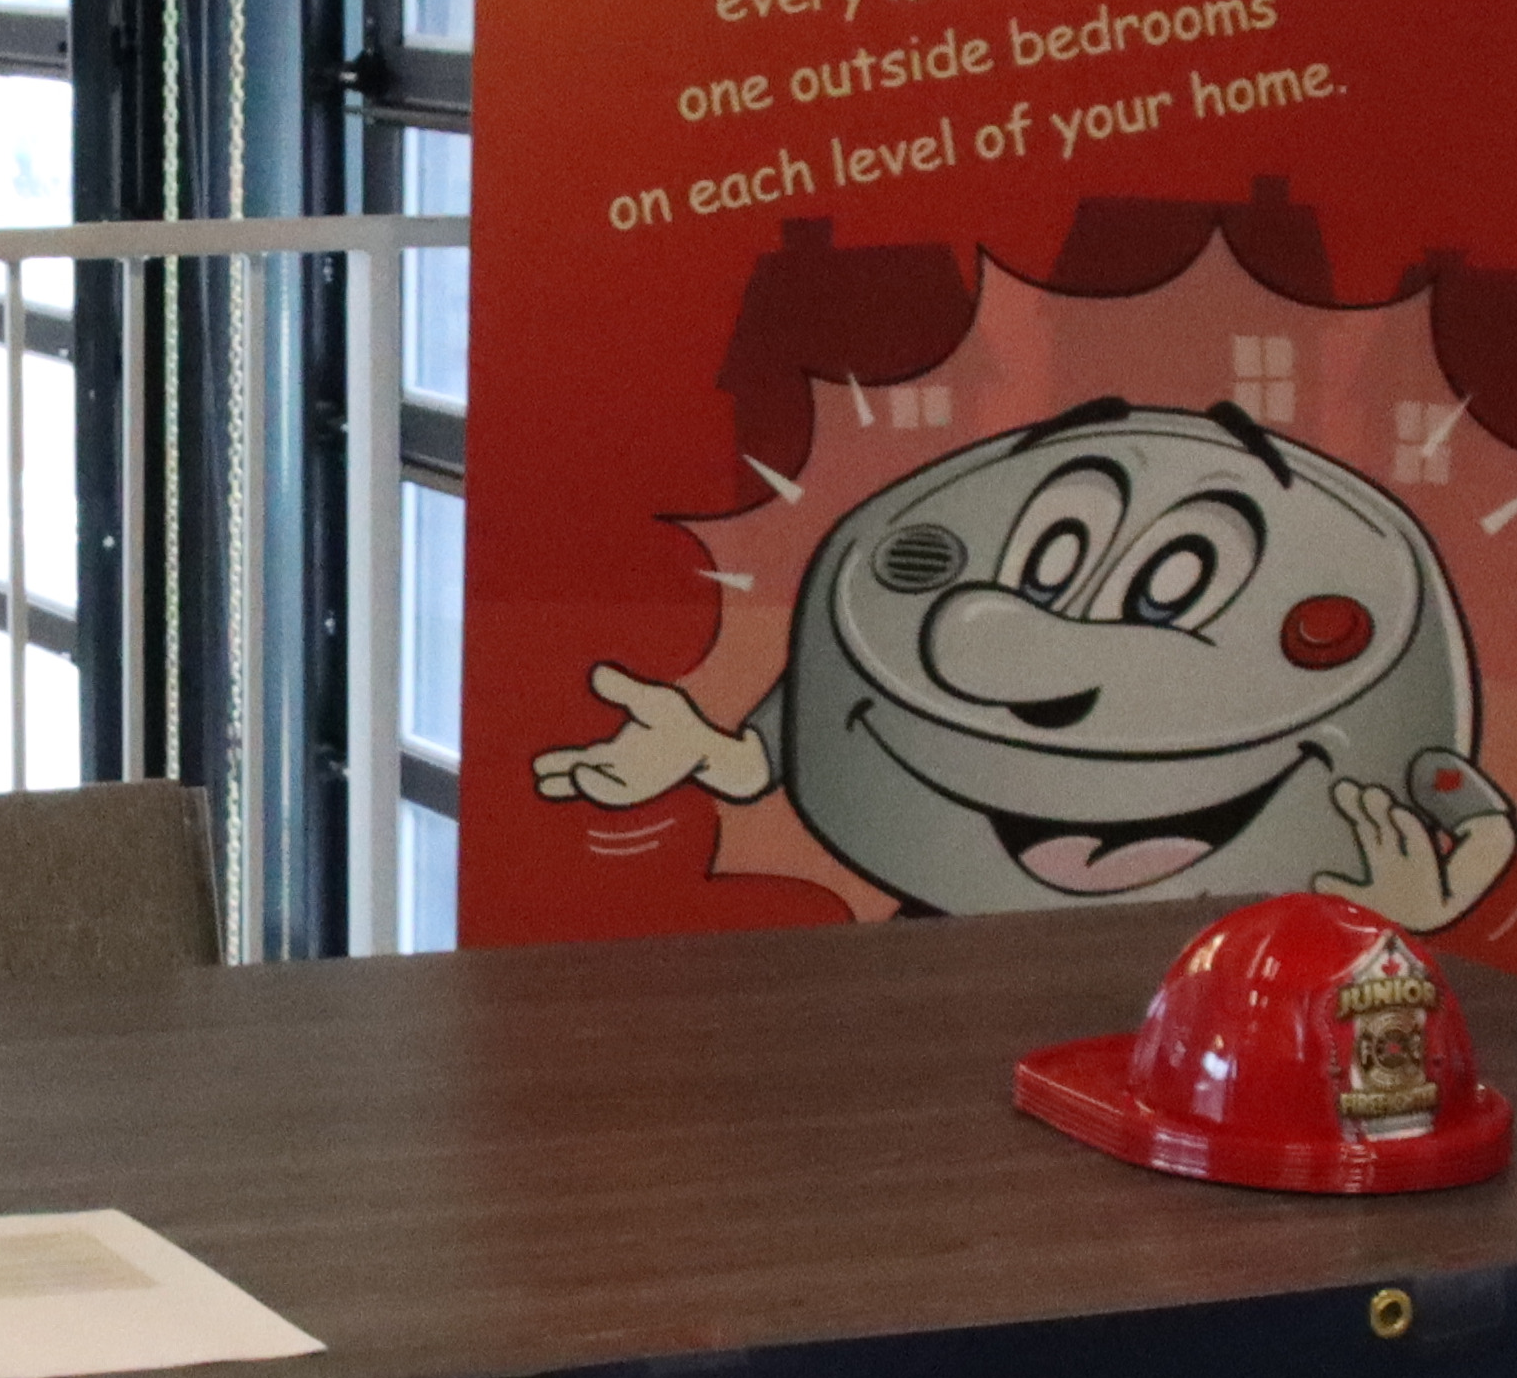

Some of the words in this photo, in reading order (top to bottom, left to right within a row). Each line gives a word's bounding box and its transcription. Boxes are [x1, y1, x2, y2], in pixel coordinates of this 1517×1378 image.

[678, 72, 773, 122] one
[792, 36, 992, 106] outside
[609, 181, 672, 231] on
[689, 142, 814, 214] each
[833, 121, 955, 186] level
[975, 107, 1031, 162] of
[1053, 86, 1171, 159] your
[1192, 58, 1348, 128] home.
[1338, 979, 1437, 1018] JUNIOR
